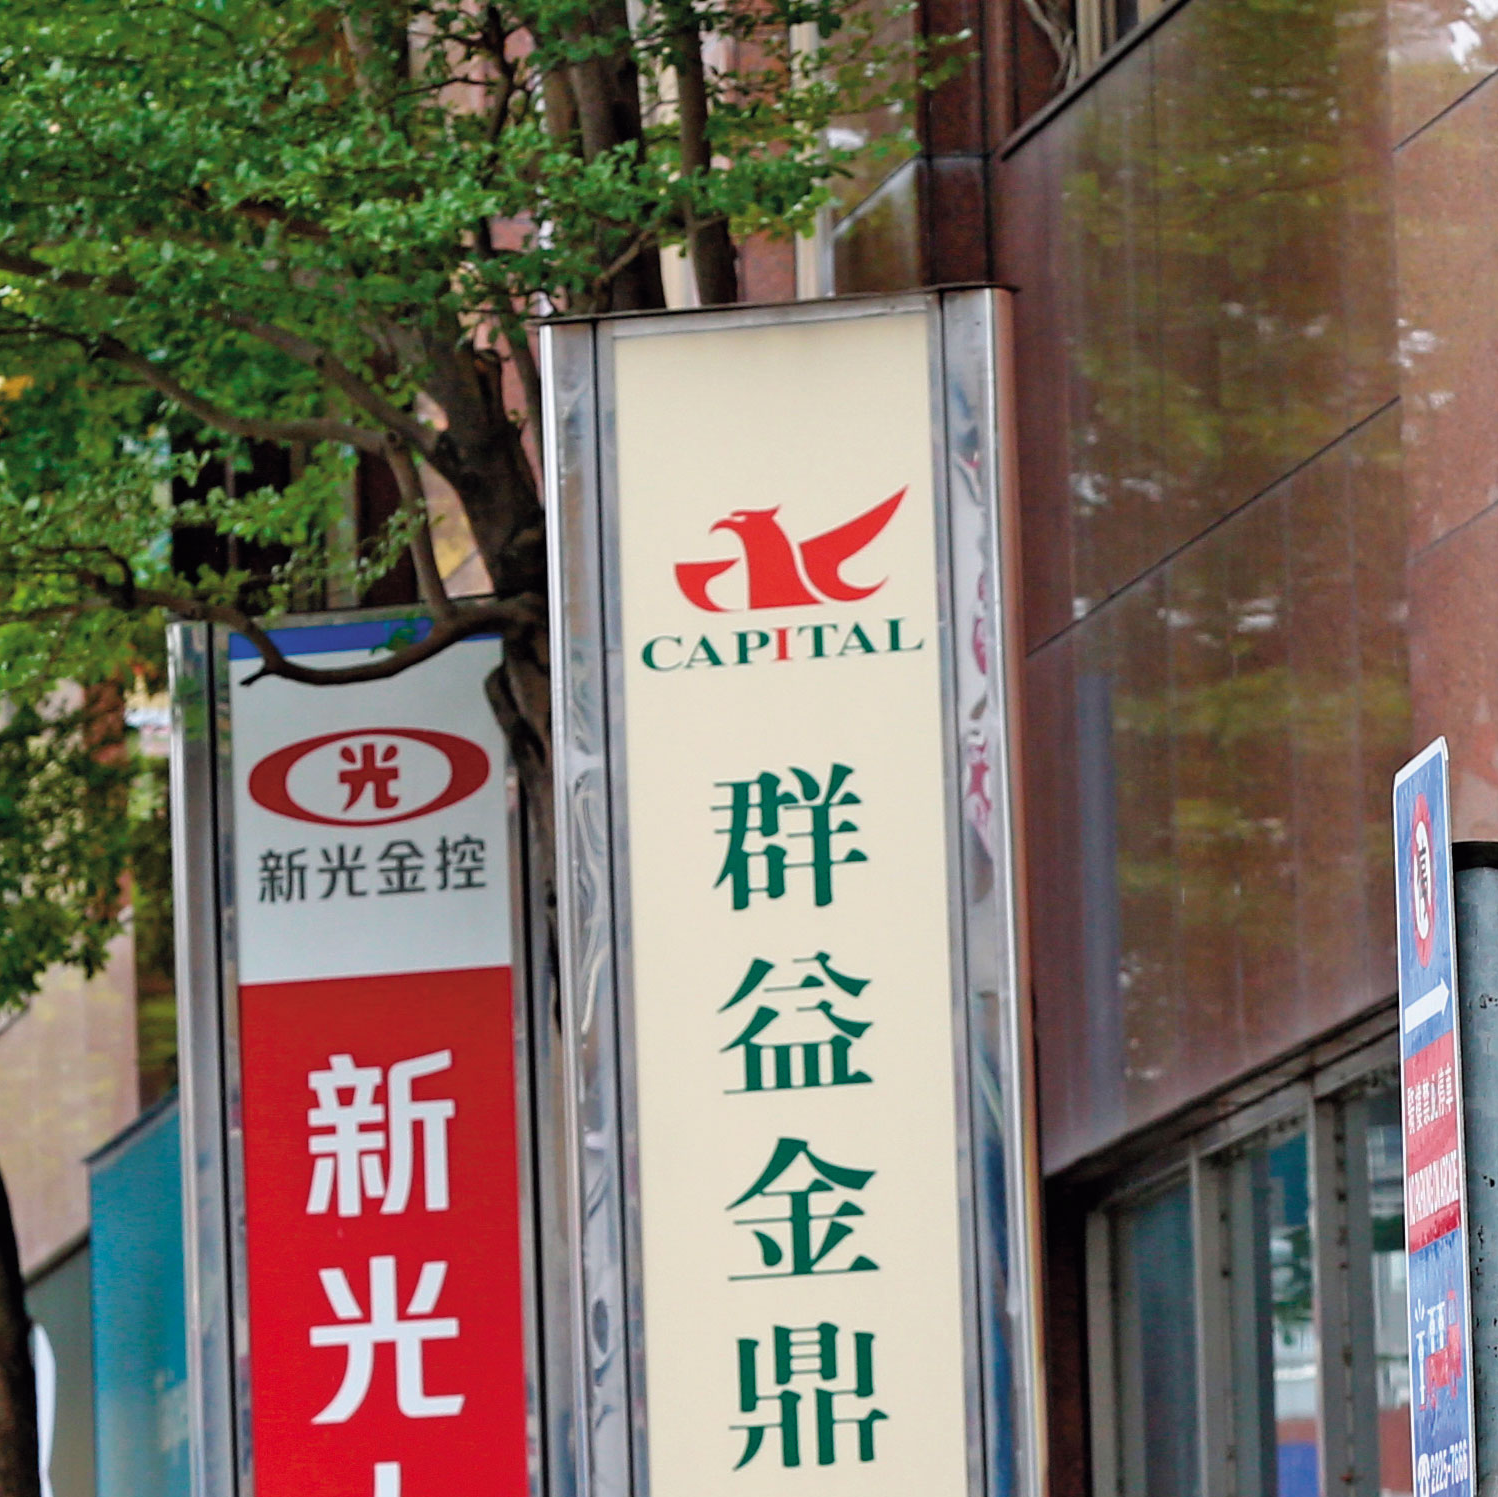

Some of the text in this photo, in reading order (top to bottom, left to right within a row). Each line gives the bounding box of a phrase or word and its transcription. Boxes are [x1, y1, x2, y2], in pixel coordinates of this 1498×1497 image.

[641, 617, 926, 672] CAPITAL
[259, 833, 488, 904] 新光金控
